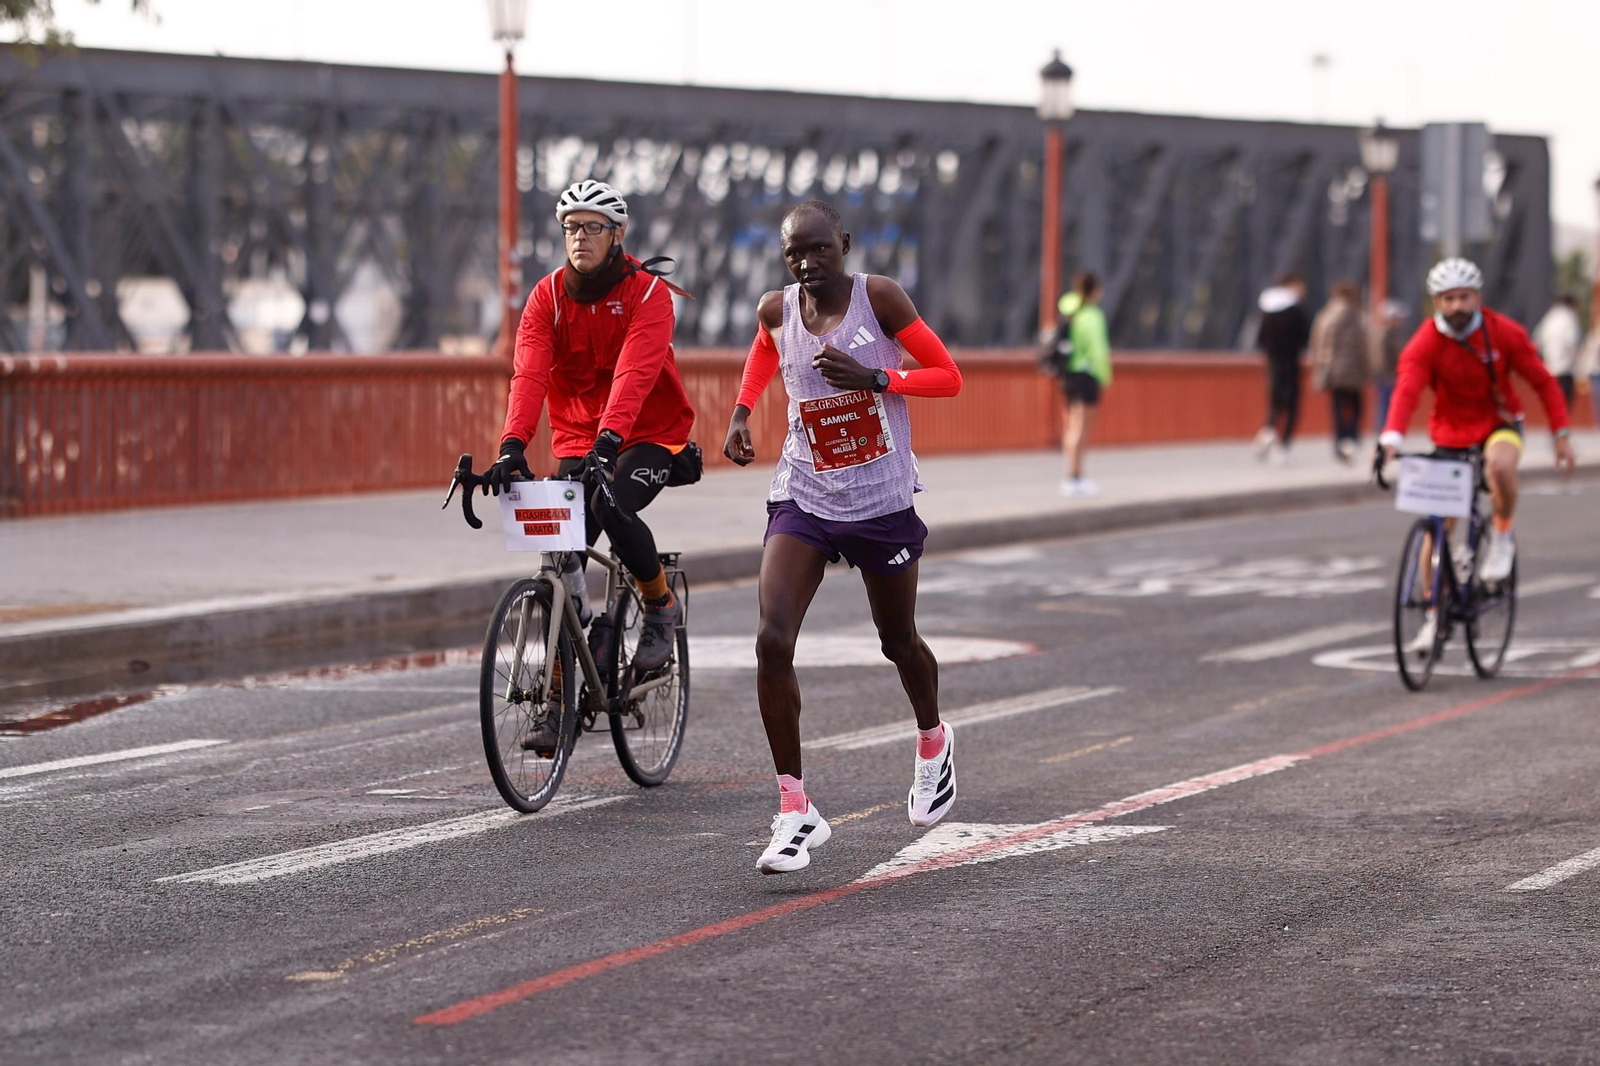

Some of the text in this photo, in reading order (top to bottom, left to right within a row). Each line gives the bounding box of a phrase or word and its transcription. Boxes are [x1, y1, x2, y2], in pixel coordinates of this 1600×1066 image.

[818, 390, 868, 410] GENERALI
[820, 412, 860, 426] SAMWEL
[839, 428, 848, 437] 5
[522, 510, 571, 519] CLASIFICADO
[524, 524, 560, 533] MARATÓN
